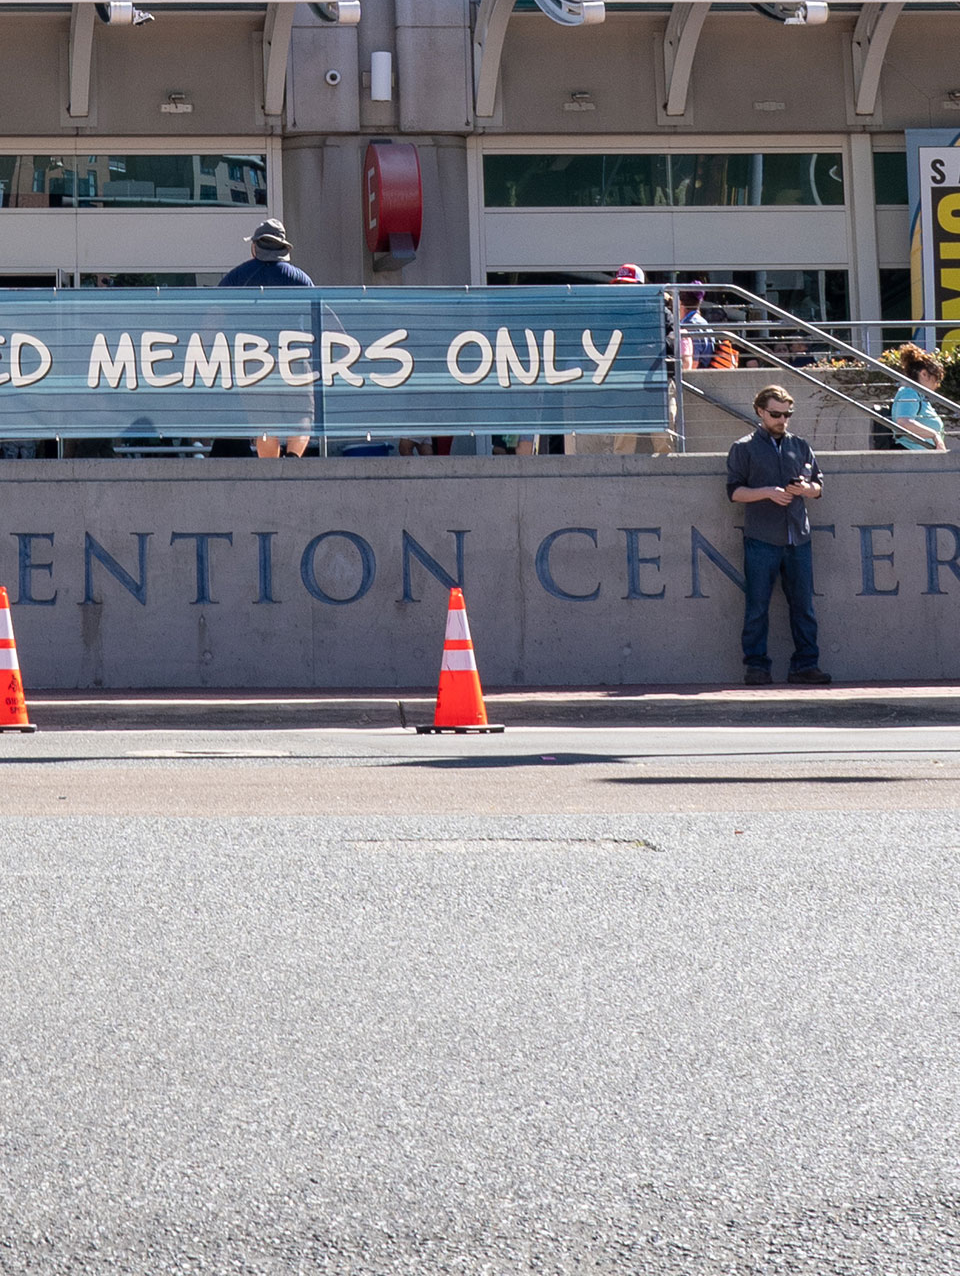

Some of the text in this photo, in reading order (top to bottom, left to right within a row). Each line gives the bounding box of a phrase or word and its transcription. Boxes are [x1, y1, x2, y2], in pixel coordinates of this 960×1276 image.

[366, 166, 378, 230] E
[930, 158, 960, 185] S
[87, 329, 415, 391] MEMBERS
[446, 327, 623, 388] ONLY
